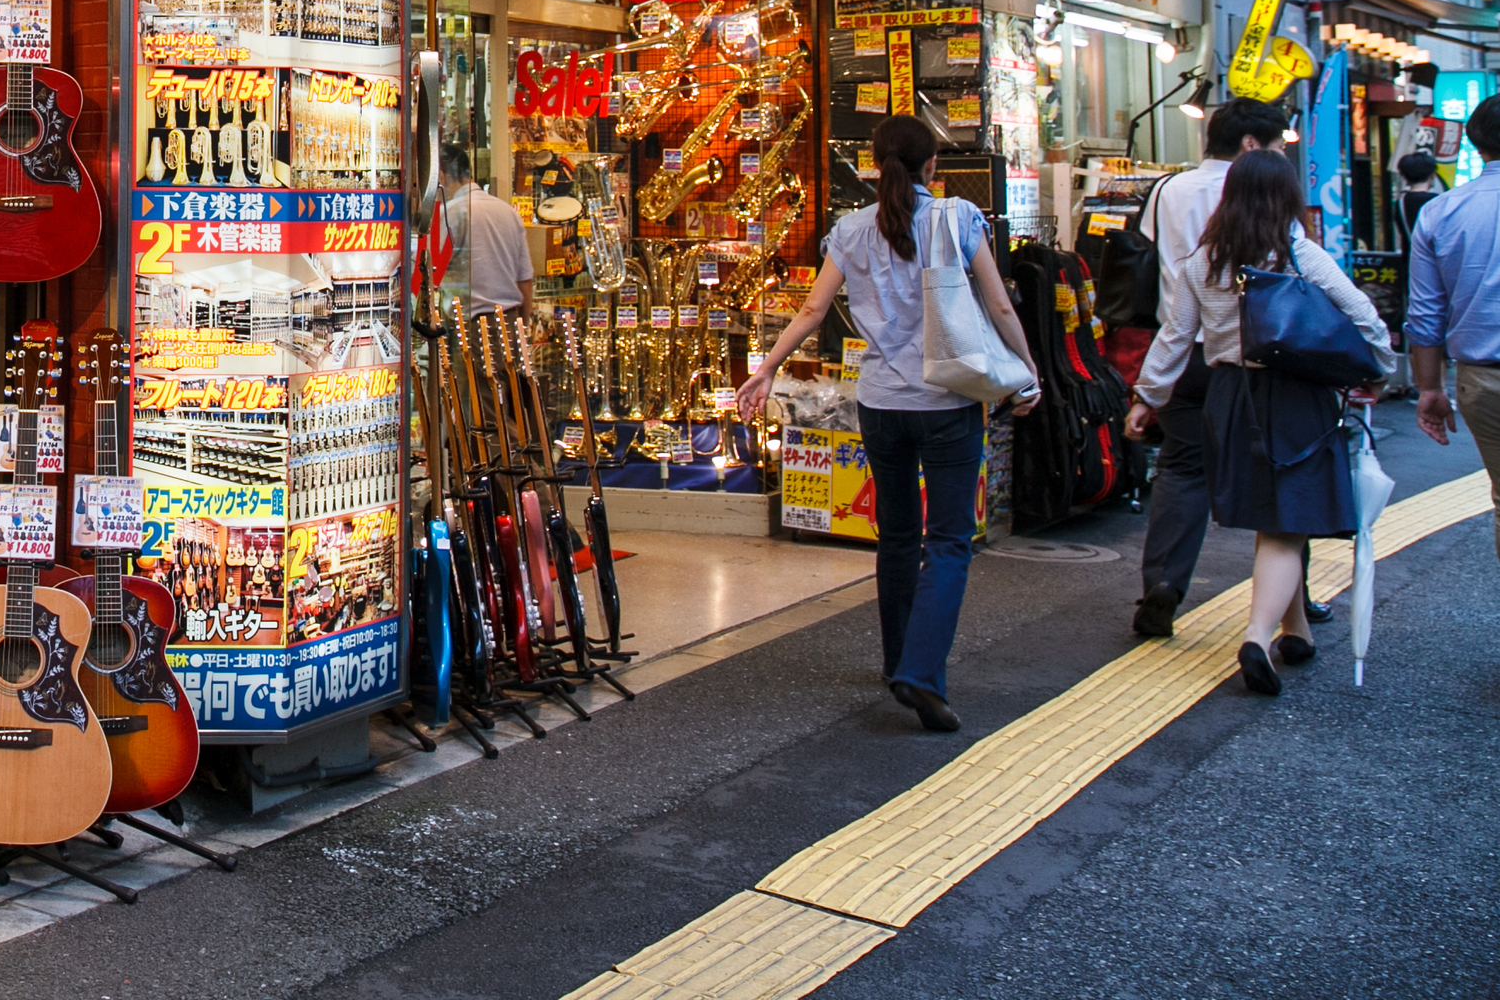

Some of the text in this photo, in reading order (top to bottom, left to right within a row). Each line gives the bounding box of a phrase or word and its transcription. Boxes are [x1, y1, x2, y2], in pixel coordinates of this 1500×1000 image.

[838, 8, 971, 29] 楽器買取り致します
[154, 34, 217, 47] ホルン40本
[145, 68, 276, 101] テューバ15本
[308, 71, 400, 109] トロンボーン80本
[514, 50, 614, 118] Sale!
[154, 191, 266, 221] 下倉楽器
[316, 193, 376, 221] 下倉楽器
[137, 221, 282, 275] 2F 木管楽器
[323, 222, 400, 252] サックス180本
[138, 378, 285, 411] フルート120本
[301, 368, 399, 407] クラリネット180本
[785, 473, 829, 485] エレキギター
[785, 484, 829, 498] エレキベース
[147, 486, 284, 518] アコースティックギター館
[141, 521, 177, 557] 2F
[289, 527, 318, 579] 2F
[317, 526, 347, 551] ドラム
[185, 608, 279, 643] 輸入ギター
